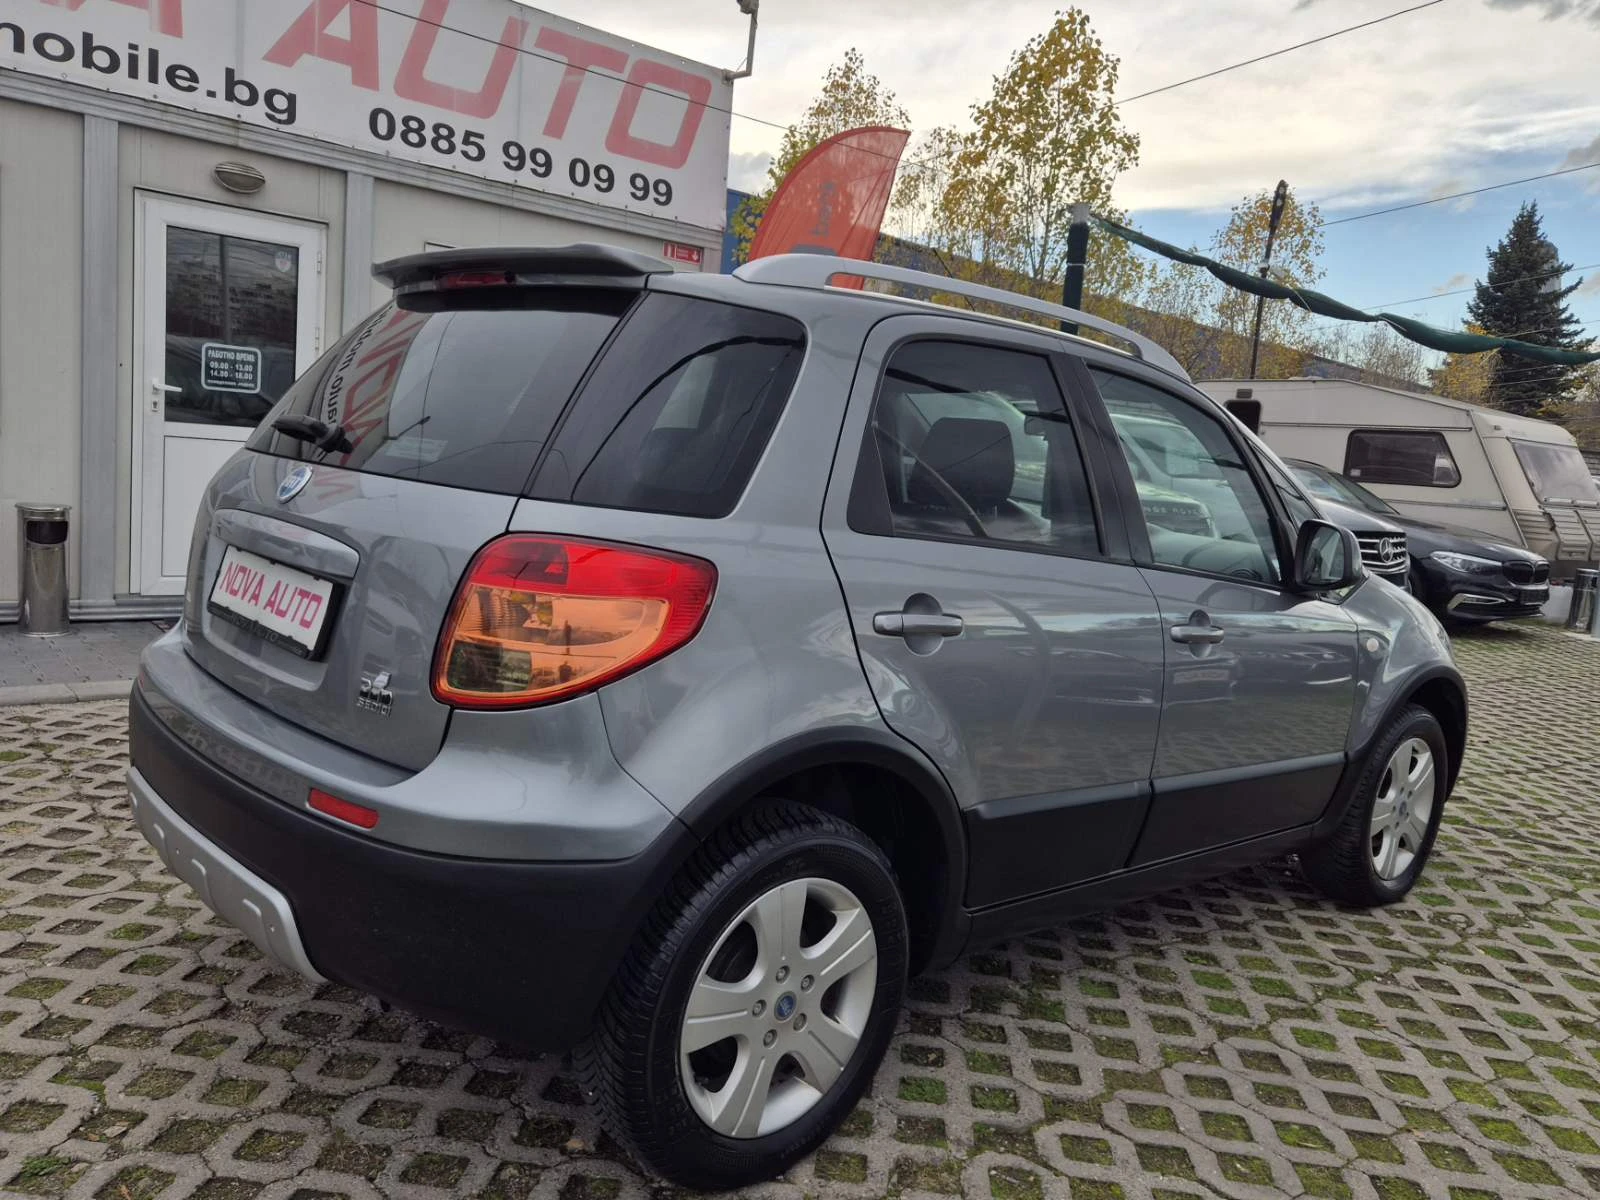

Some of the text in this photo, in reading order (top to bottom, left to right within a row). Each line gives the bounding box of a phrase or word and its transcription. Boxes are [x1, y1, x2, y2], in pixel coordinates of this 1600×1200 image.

[261, 0, 713, 170] AUTO
[368, 107, 673, 206] 0885 99 09 99
[219, 561, 266, 607] NOVA
[263, 579, 324, 630] AUTO
